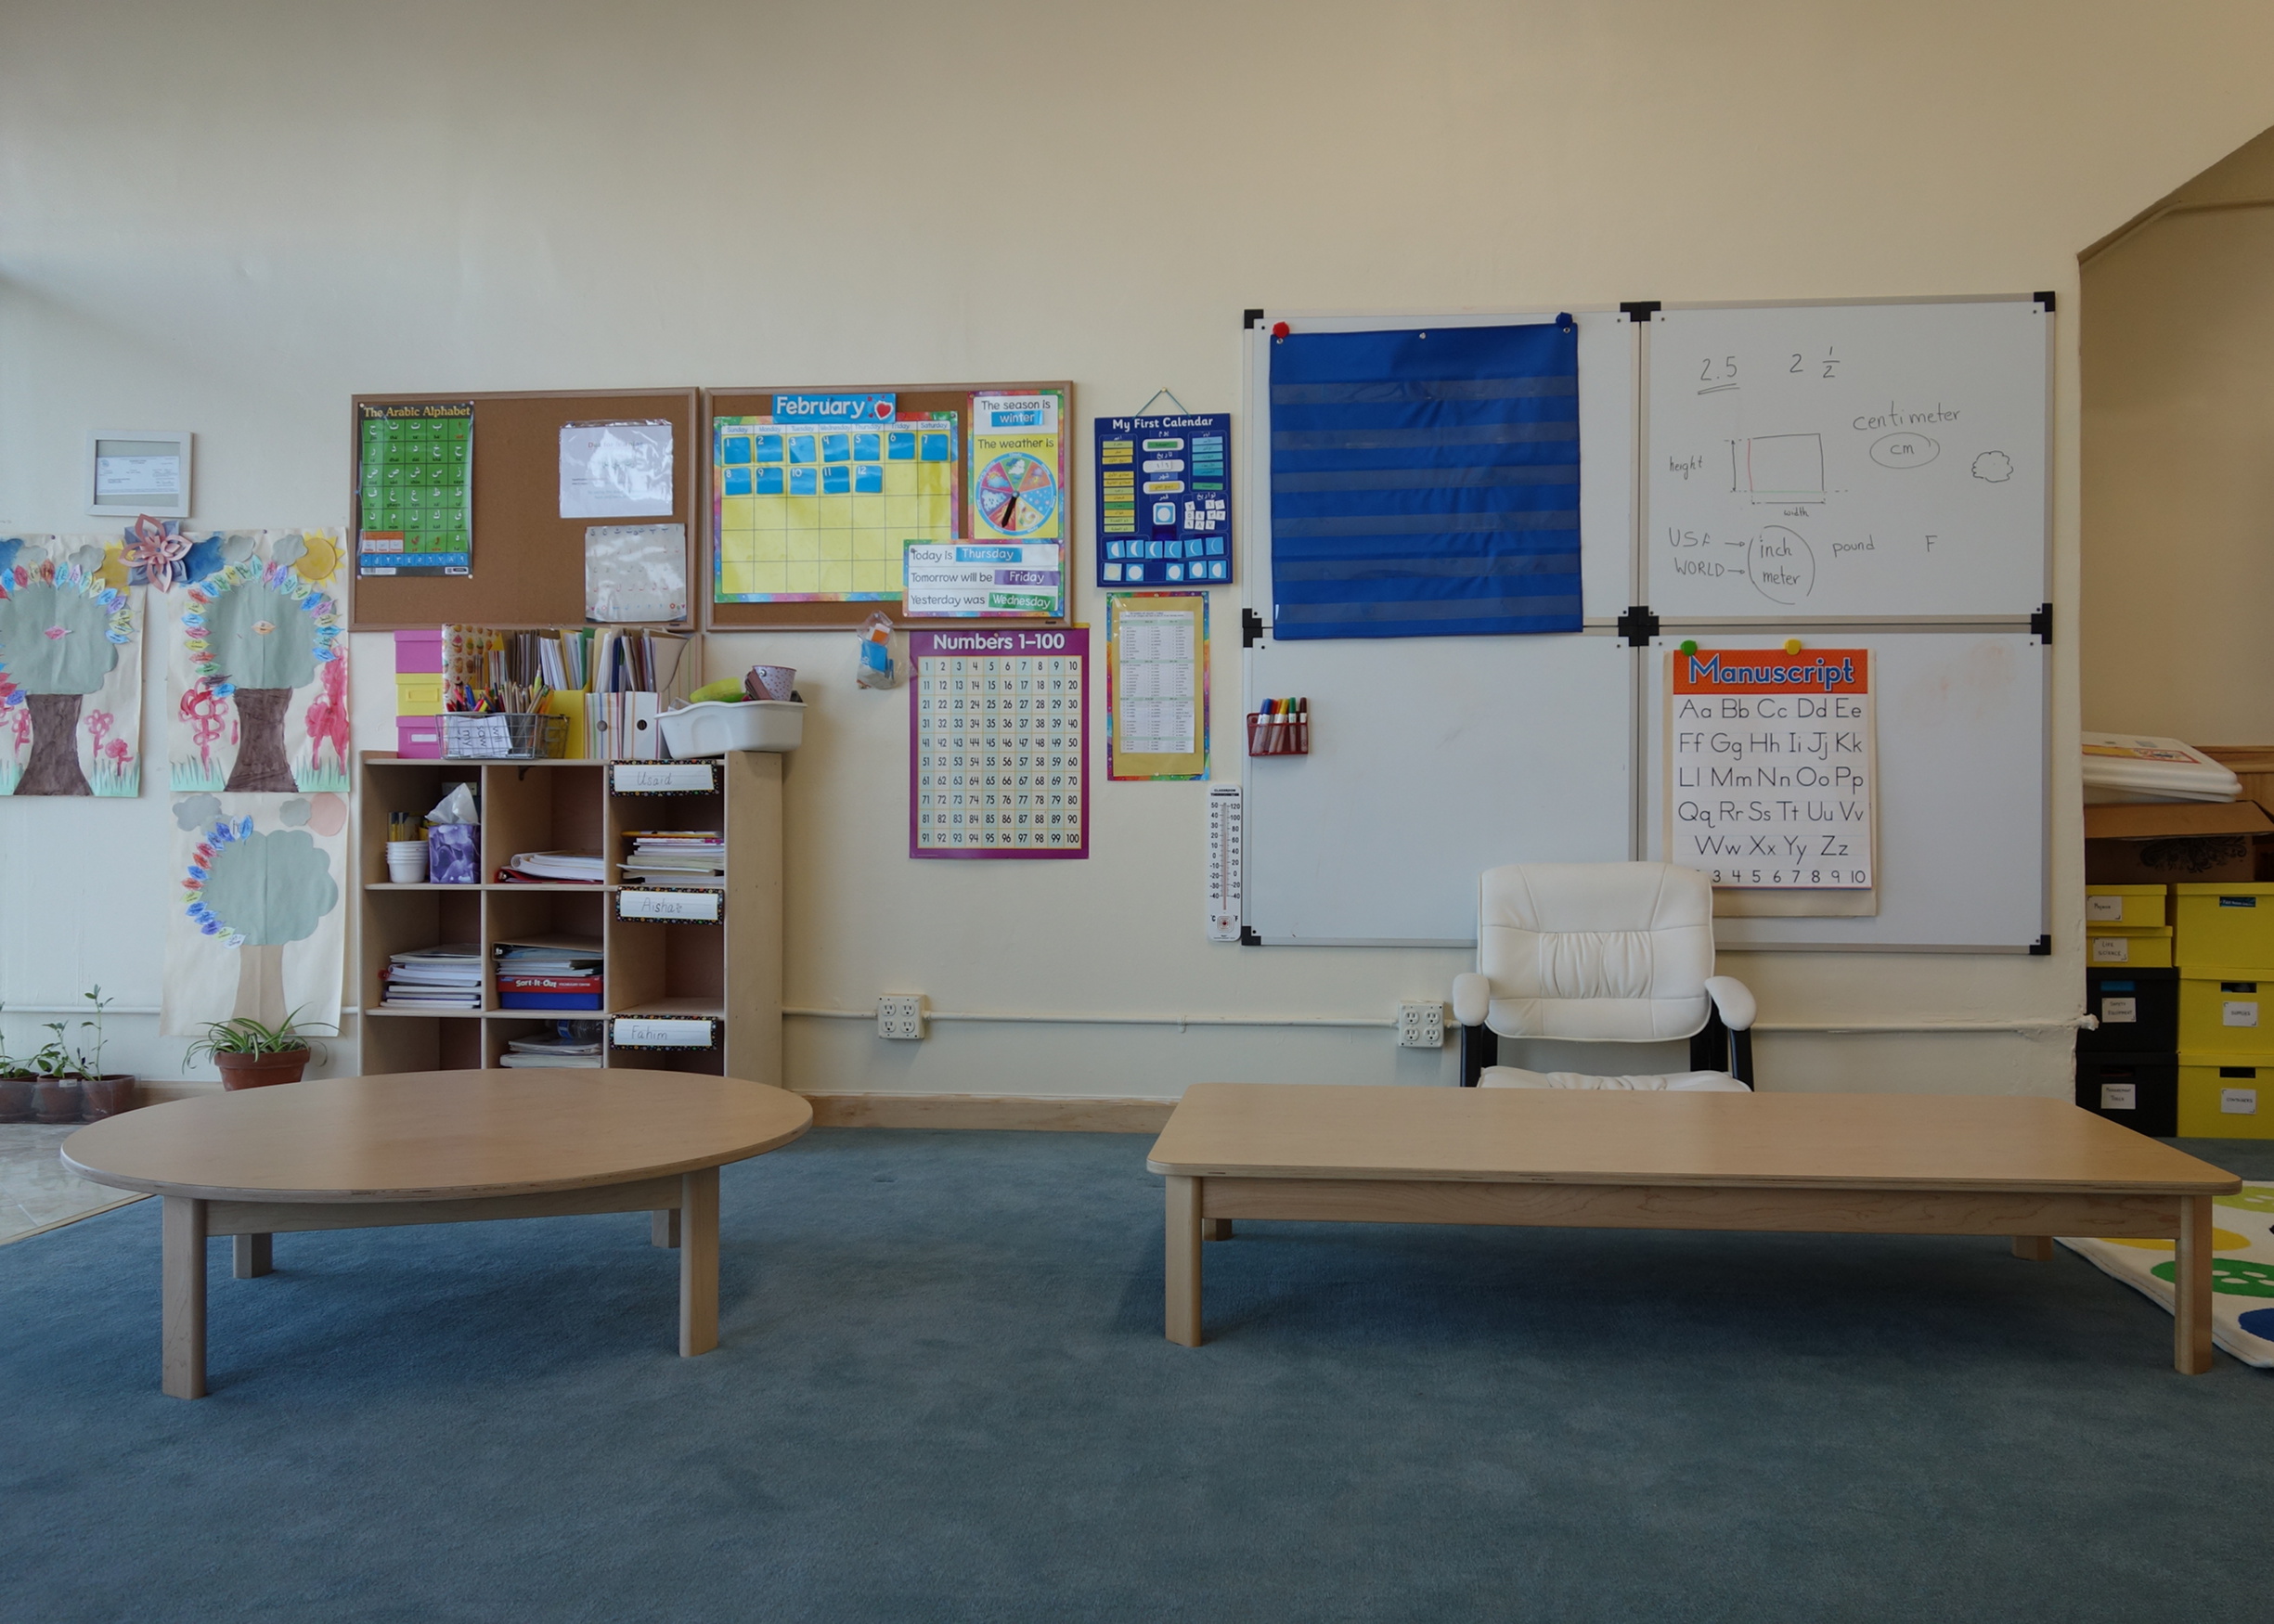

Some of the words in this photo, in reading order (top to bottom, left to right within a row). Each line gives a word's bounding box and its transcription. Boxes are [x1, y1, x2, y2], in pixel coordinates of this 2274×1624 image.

[1700, 355, 1738, 381] 2.5
[1789, 354, 1803, 373] 2
[364, 406, 383, 418] The
[386, 406, 420, 418] Arabic
[422, 406, 471, 418] Alphabet
[776, 395, 865, 419] February
[981, 400, 1001, 410] The
[1002, 400, 1040, 410] season
[1042, 399, 1051, 409] is
[1000, 412, 1035, 423] winter
[1853, 400, 1961, 431] centimeter
[758, 425, 782, 433] Monday
[791, 424, 815, 432] Tuesday
[1113, 419, 1131, 432] My
[1134, 418, 1159, 429] First
[1163, 416, 1214, 428] Calendar
[726, 438, 730, 446] 1
[758, 435, 764, 445] 2
[791, 437, 796, 446] 3
[823, 435, 830, 445] 4
[855, 434, 861, 444] 5
[890, 432, 897, 442] 6
[923, 435, 928, 444] 7
[977, 438, 997, 449] The
[1000, 437, 1044, 448] weather
[1046, 438, 1054, 448] is
[1890, 444, 1915, 455] cm
[726, 469, 732, 479] 8
[758, 467, 764, 476] 9
[792, 468, 802, 478] 10
[824, 467, 832, 476] 11
[858, 466, 867, 475] 12
[1669, 455, 1703, 481] height
[1783, 507, 1809, 517] width
[1760, 536, 1792, 559] inch
[1832, 534, 1876, 558] pound
[1925, 535, 1938, 553] F
[911, 549, 942, 563] Today
[944, 550, 953, 561] is
[962, 548, 1014, 561] Thursday
[1674, 557, 1725, 578] WORLD
[1762, 565, 1802, 586] meter
[911, 572, 959, 583] Tomorrow
[961, 572, 977, 583] will
[979, 572, 993, 583] be
[1009, 571, 1045, 584] Friday
[911, 595, 962, 607] Yesterday
[963, 597, 986, 605] was
[992, 594, 1052, 610] Wednesday
[933, 633, 1014, 651] Numbers
[924, 662, 928, 671] 1
[940, 662, 946, 671] 2
[956, 662, 962, 671] 3
[973, 662, 978, 671] 4
[988, 662, 994, 671] 5
[1005, 662, 1011, 671] 6
[1022, 662, 1027, 671] 7
[1038, 662, 1043, 671] 8
[1053, 662, 1060, 671] 9
[1069, 662, 1078, 671] 10
[1689, 653, 1854, 690] Manuscript
[1679, 699, 1712, 718] Aa
[1722, 699, 1750, 718] Bb
[1757, 699, 1788, 718] Cc
[1798, 699, 1827, 718] Dd
[1836, 699, 1862, 718] Ee
[462, 729, 472, 747] my
[477, 725, 487, 748] saw
[1679, 732, 1704, 753] Ff
[1711, 732, 1742, 761] Gg
[1751, 732, 1779, 753] Hh
[1789, 732, 1801, 753] Ii
[1807, 732, 1828, 761] Jj
[1836, 732, 1862, 753] Kk
[637, 771, 674, 786] Usaid
[1679, 767, 1700, 787] Ll
[1712, 767, 1751, 787] Mm
[1758, 767, 1790, 787] Nn
[1796, 767, 1829, 787] Oo
[1836, 767, 1864, 795] Pp
[1678, 801, 1715, 829] Qq
[1720, 801, 1743, 821] Rr
[1749, 801, 1771, 821] Ss
[1776, 801, 1799, 821] Tt
[1807, 801, 1833, 821] Uu
[1840, 801, 1864, 821] Vv
[1017, 833, 1027, 843] 97
[1034, 833, 1044, 843] 98
[1051, 833, 1061, 843] 99
[1066, 833, 1079, 843] 100
[1695, 835, 1741, 856] Ww
[1749, 835, 1776, 856] Xx
[1784, 835, 1807, 865] Yy
[1820, 835, 1849, 856] Zz
[1712, 870, 1721, 883] 3
[1732, 870, 1741, 883] 4
[1751, 870, 1761, 883] 5
[1773, 870, 1781, 883] 6
[1792, 870, 1801, 883] 7
[1811, 870, 1820, 883] 8
[1831, 870, 1840, 883] 9
[1851, 870, 1866, 883] 10
[641, 896, 675, 913] Aisha
[631, 1025, 667, 1040] Fahim
